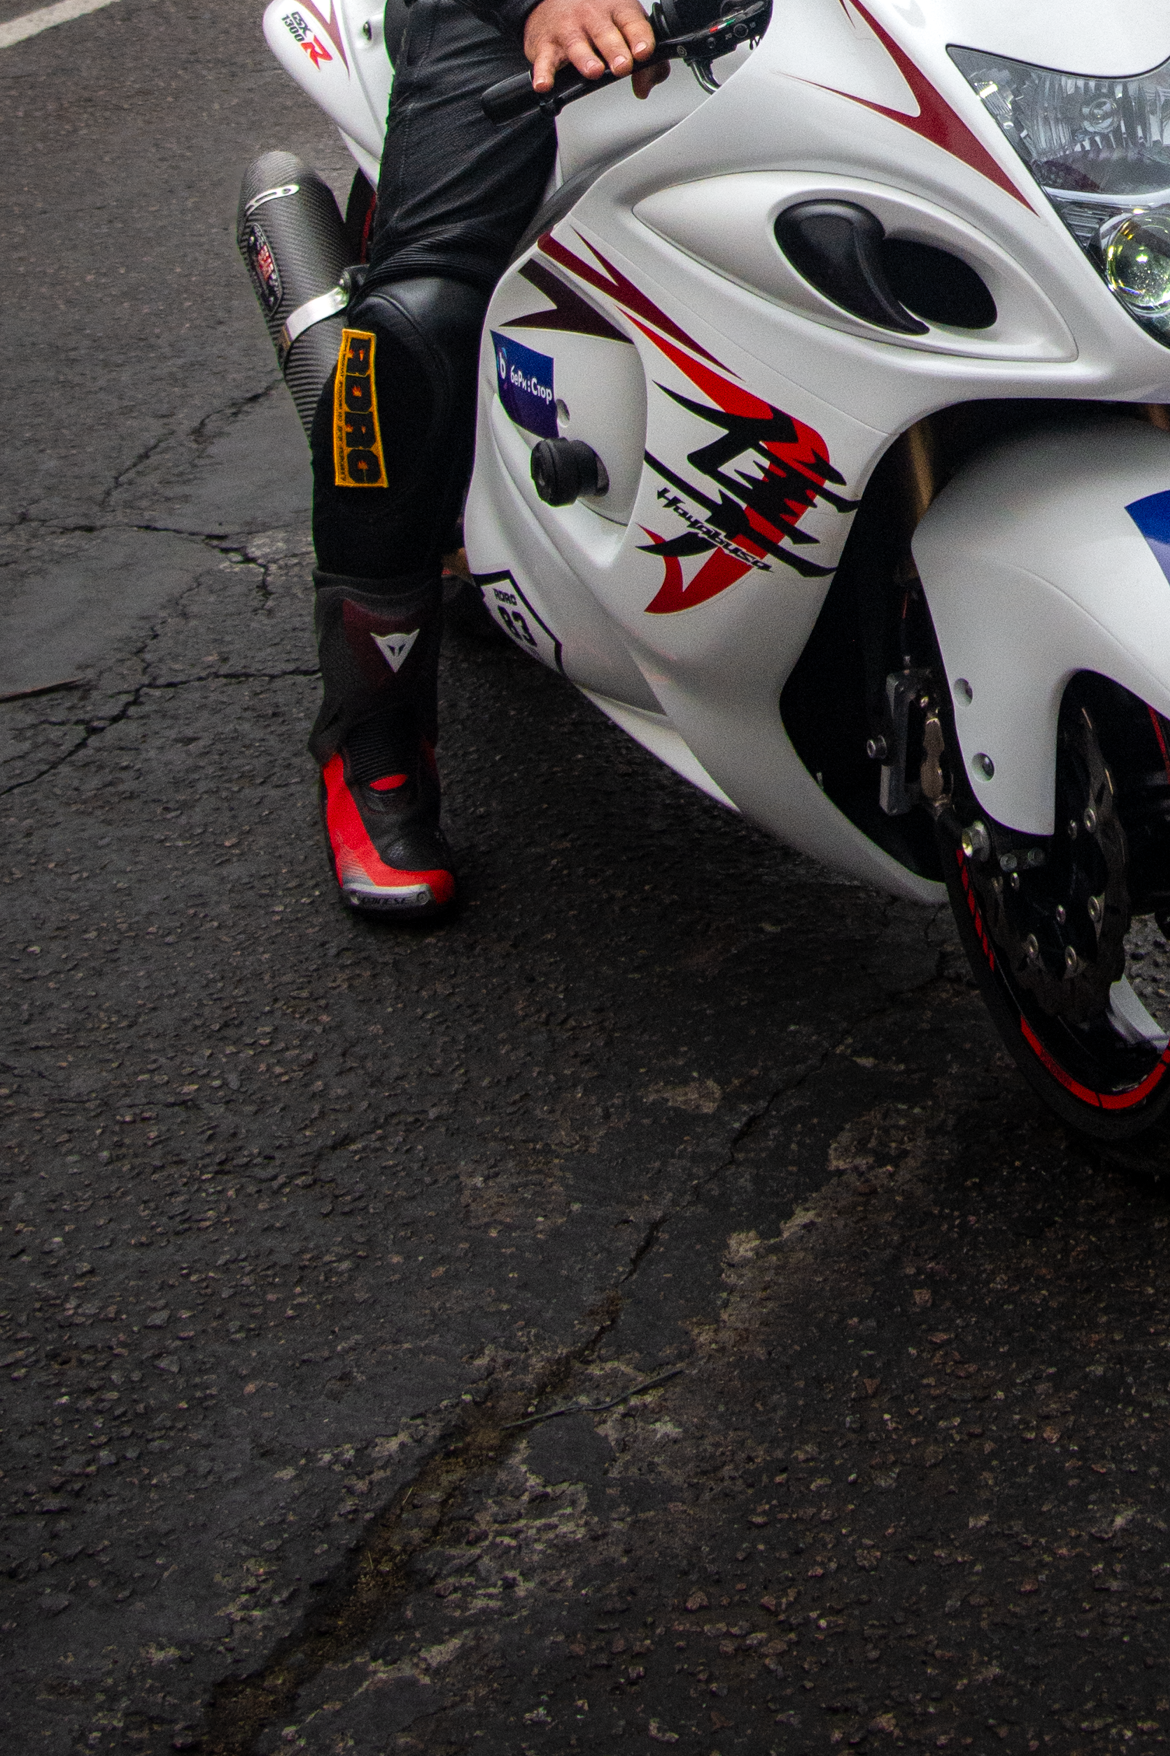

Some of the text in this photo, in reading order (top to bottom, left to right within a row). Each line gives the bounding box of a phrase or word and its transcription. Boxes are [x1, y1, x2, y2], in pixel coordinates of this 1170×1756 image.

[281, 14, 305, 43] 1300
[291, 11, 312, 38] GSX
[300, 34, 333, 71] R
[497, 605, 538, 648] 83
